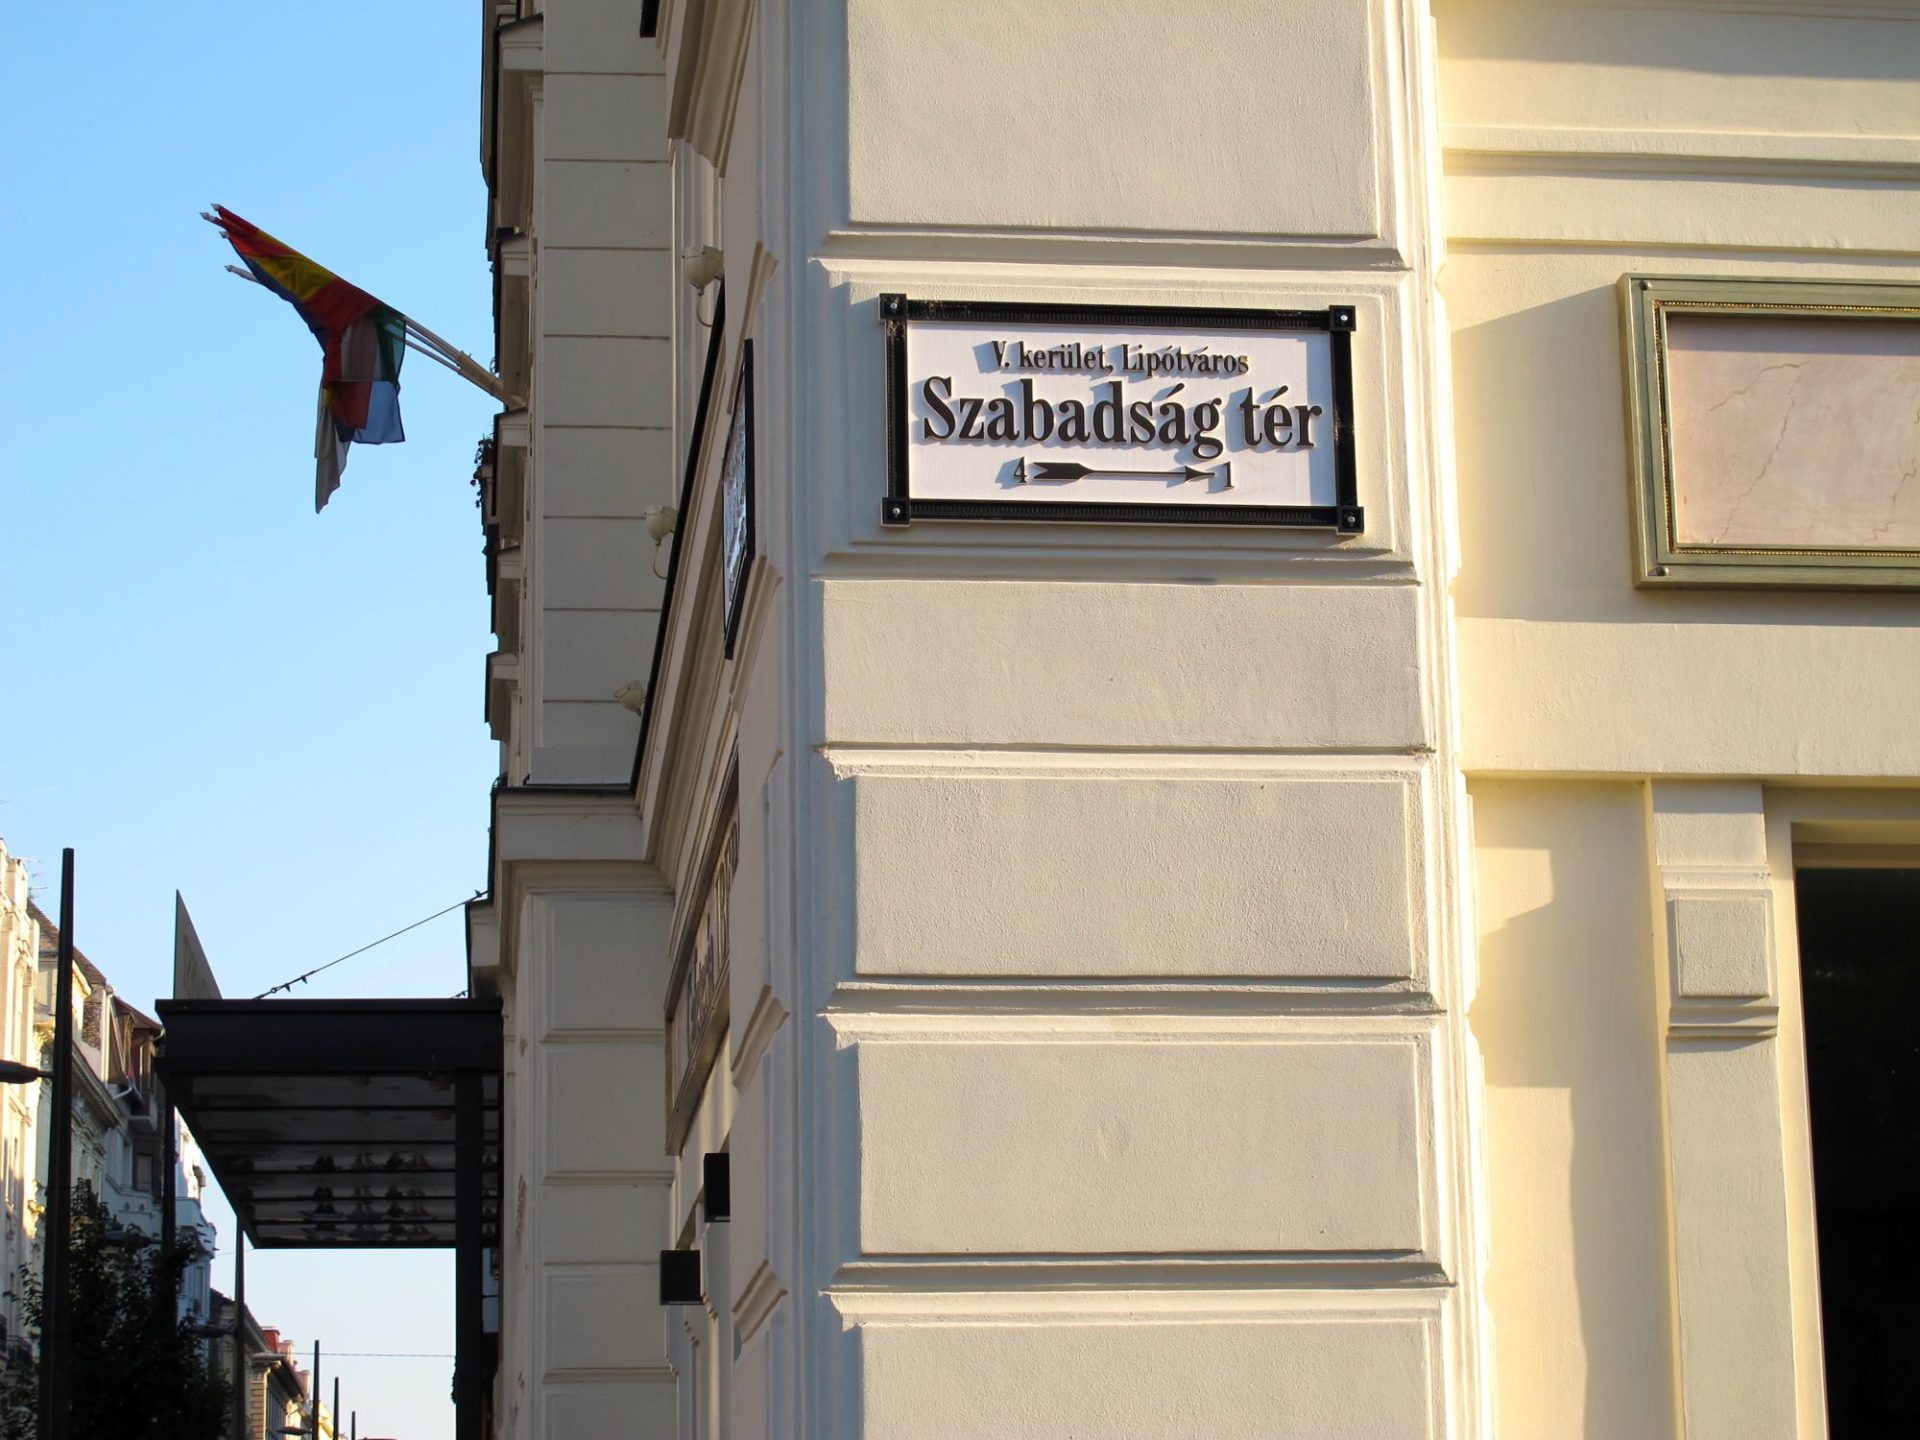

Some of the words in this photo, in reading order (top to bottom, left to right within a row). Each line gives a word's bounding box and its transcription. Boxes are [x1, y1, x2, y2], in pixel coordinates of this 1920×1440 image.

[992, 340, 1010, 368] V.
[1019, 340, 1114, 375] kerület,
[1121, 343, 1249, 377] Lipótváros
[922, 375, 1223, 460] Szabadság
[1240, 384, 1322, 447] tér
[1013, 456, 1028, 484] 4
[1223, 461, 1235, 489] 1
